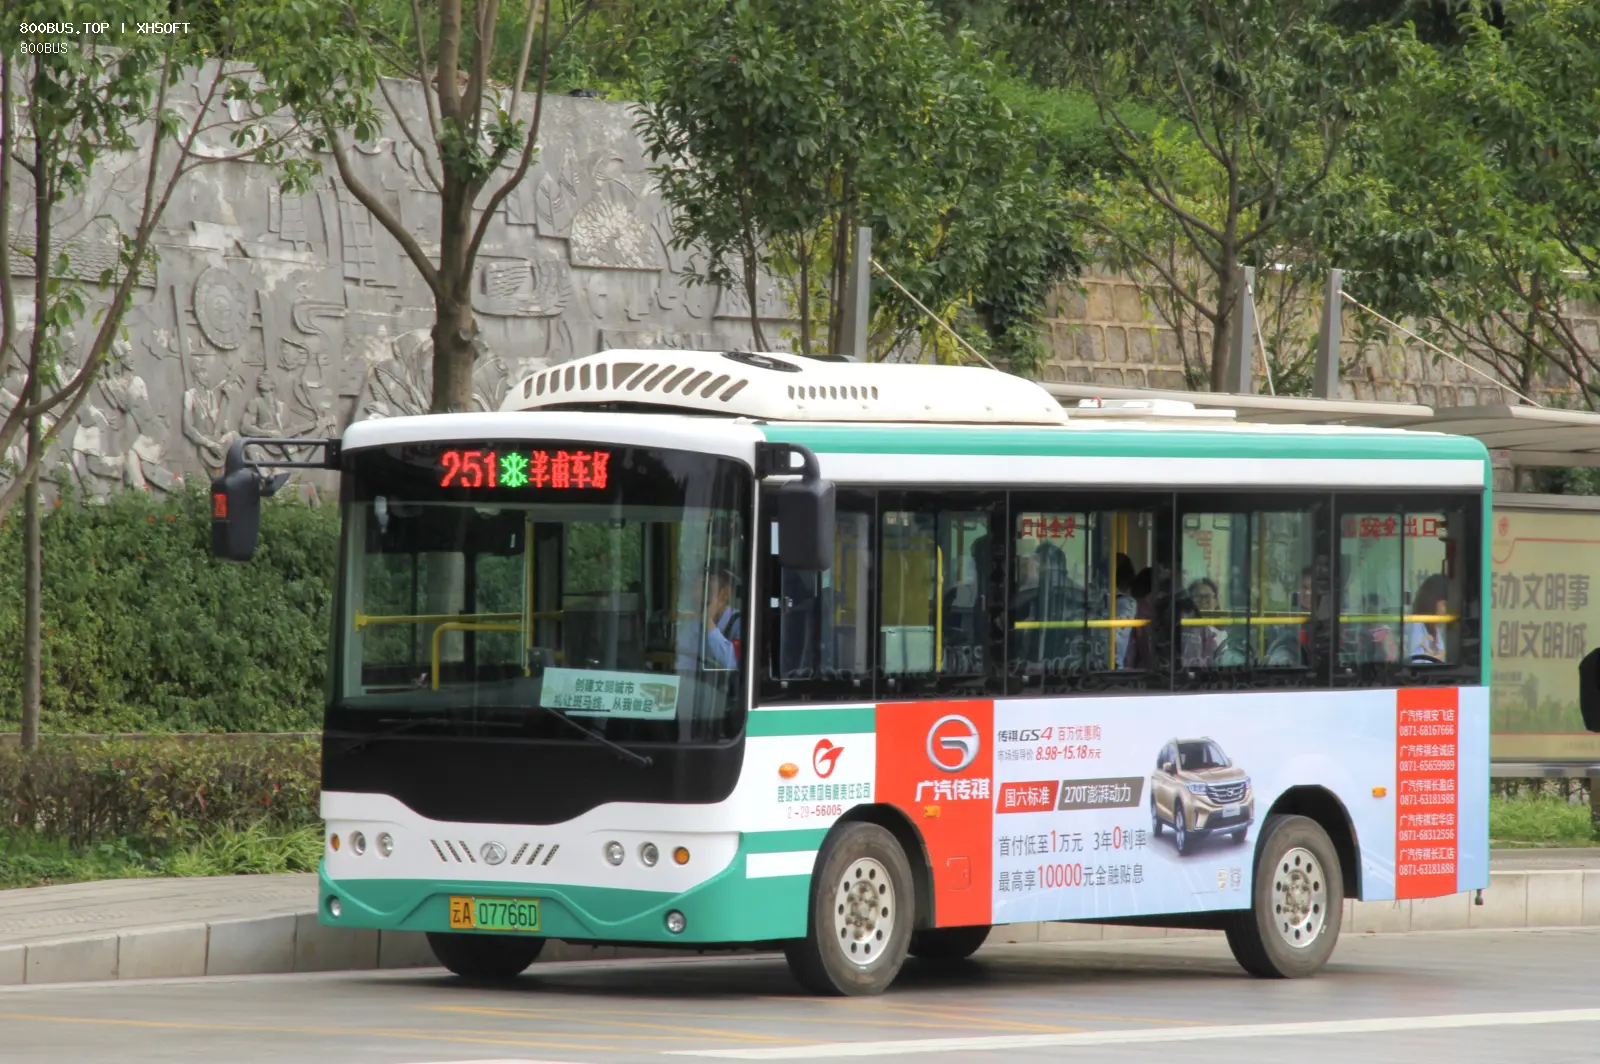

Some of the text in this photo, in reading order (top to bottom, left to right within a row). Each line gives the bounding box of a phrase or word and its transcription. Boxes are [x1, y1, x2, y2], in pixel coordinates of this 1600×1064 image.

[440, 450, 496, 487] 251
[1490, 620, 1588, 660] 创文明城
[575, 677, 636, 694] 创建文明城市
[777, 782, 871, 803] 昆明公交集团有限责任公司
[914, 777, 990, 802] 广汽传祺
[1004, 786, 1051, 808] 国六标准
[1064, 783, 1132, 804] 270T澎湃动力
[998, 826, 1148, 856] 首付低至1万元 3年0利率
[997, 863, 1145, 893] 最高享10000元金融贴息
